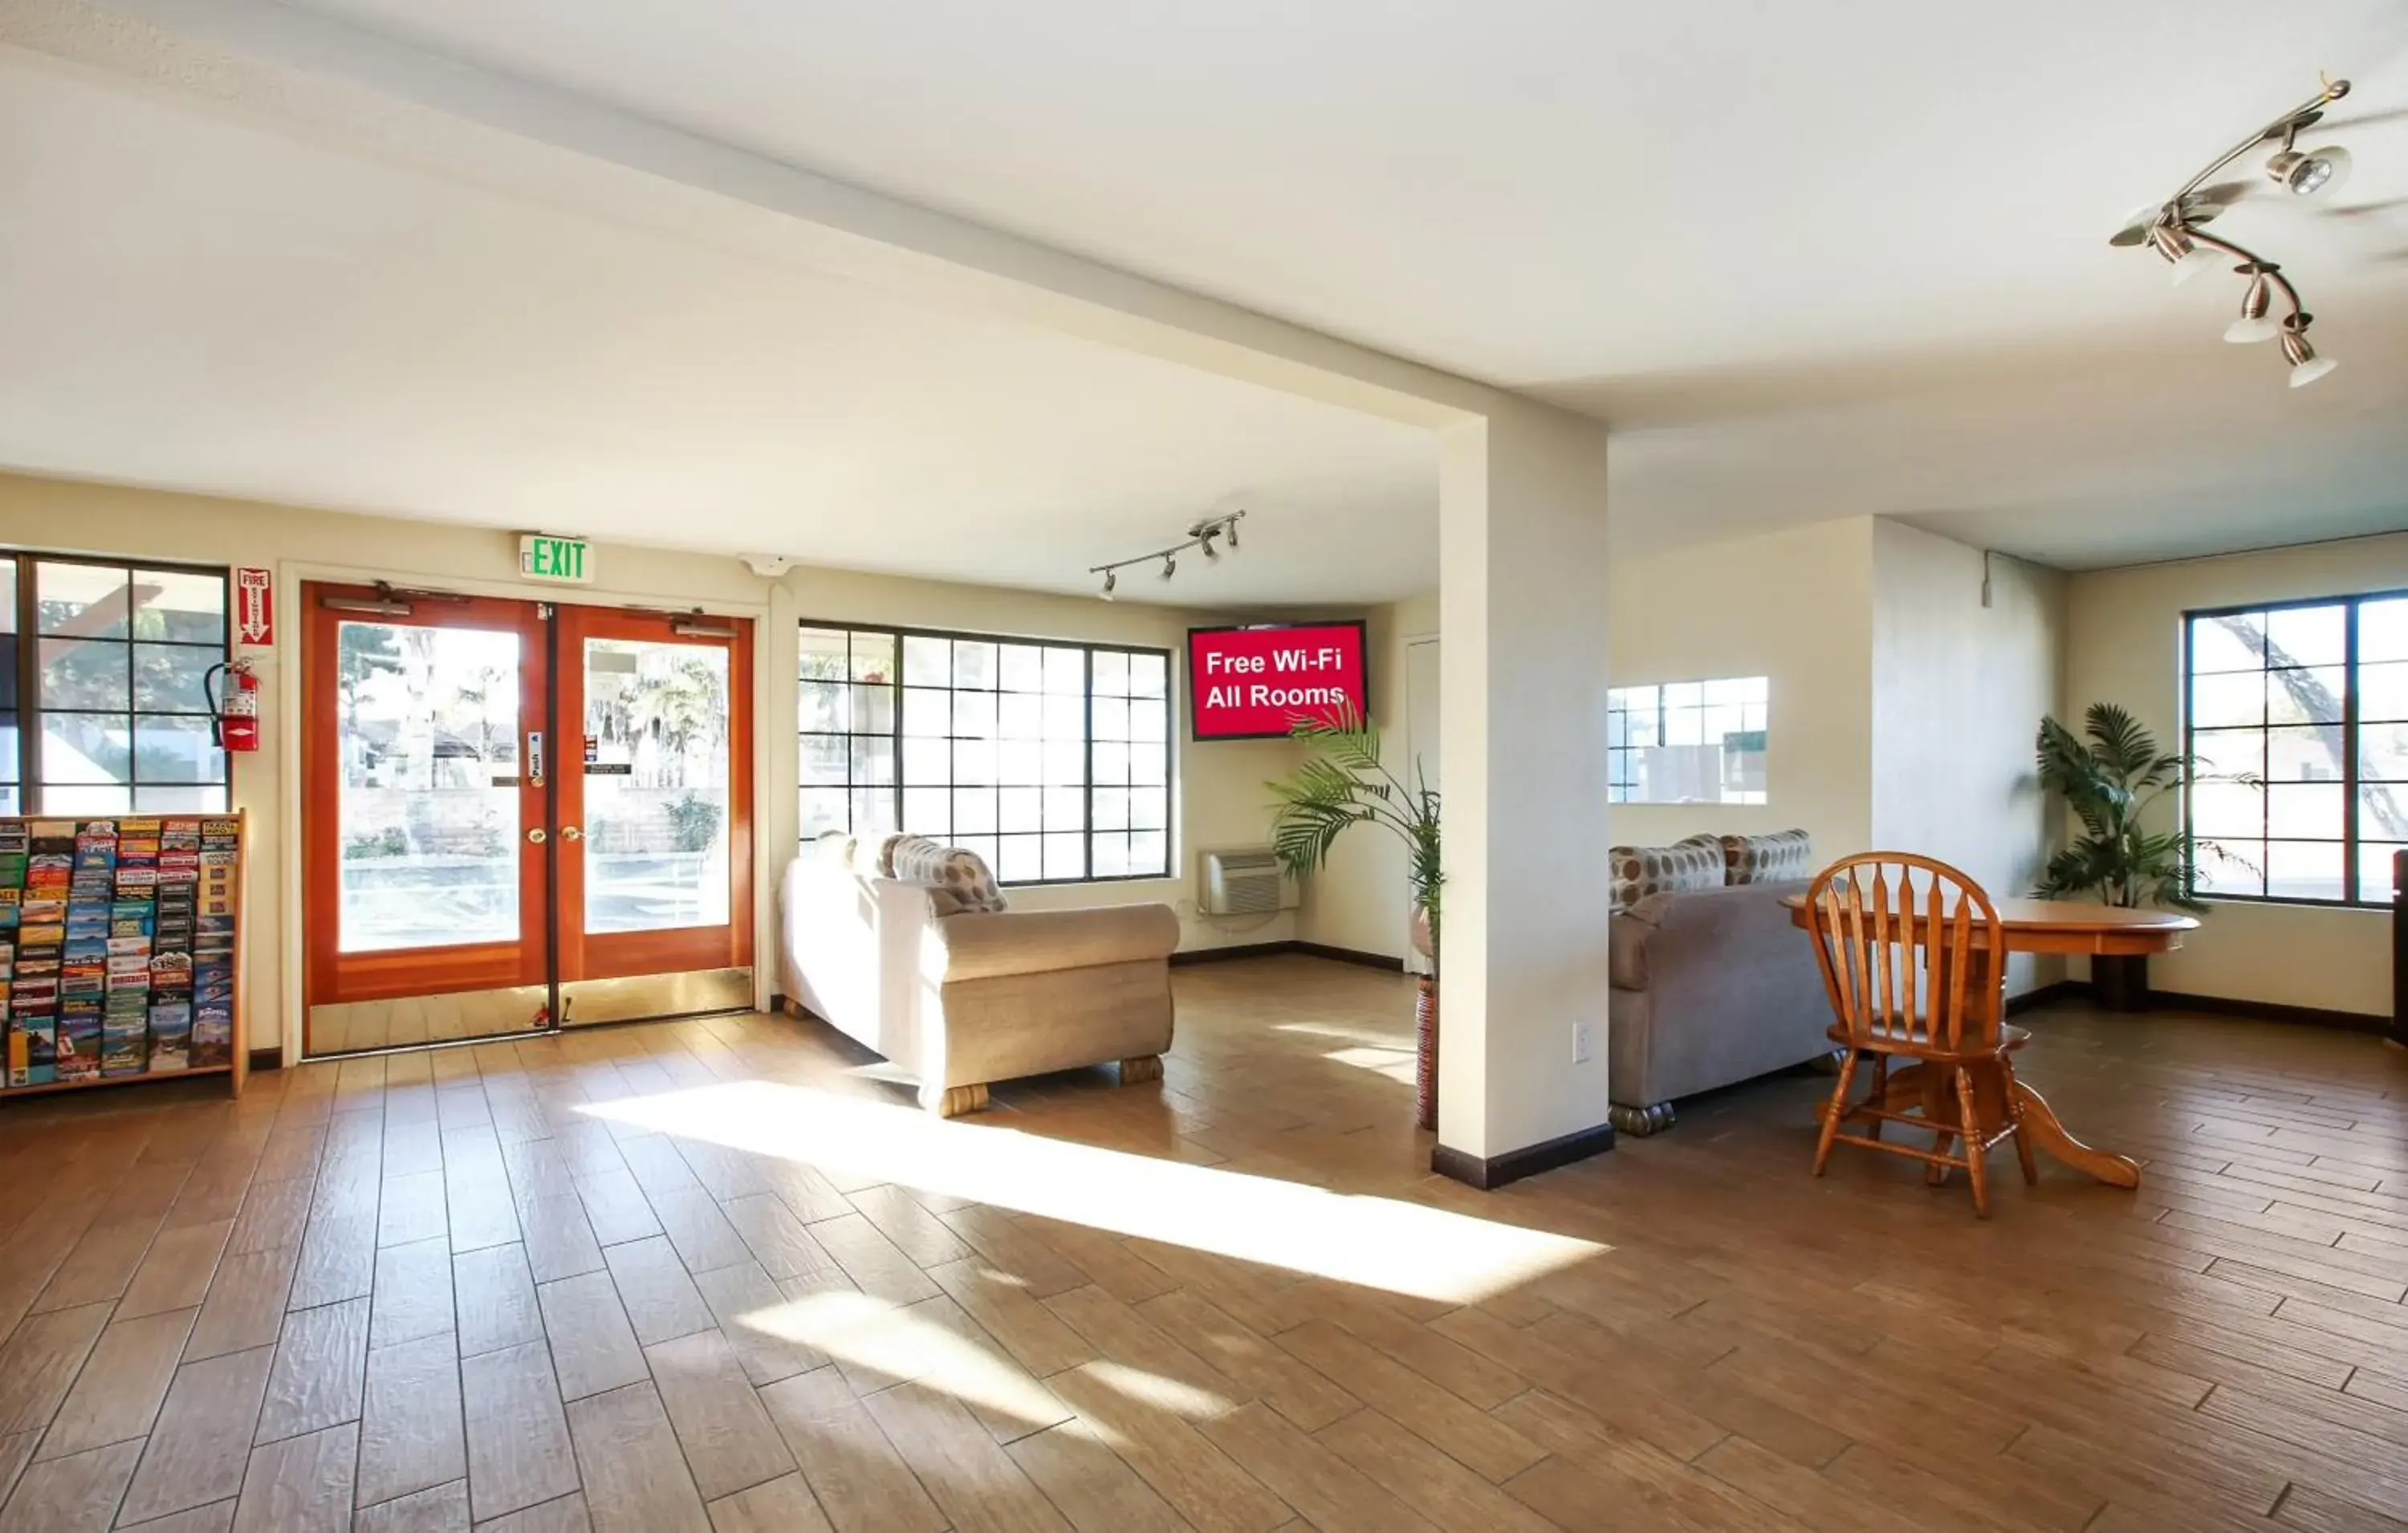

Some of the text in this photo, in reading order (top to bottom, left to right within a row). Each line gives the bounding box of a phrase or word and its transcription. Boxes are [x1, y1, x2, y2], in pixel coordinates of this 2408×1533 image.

[534, 539, 586, 579] EXIT
[243, 574, 266, 587] FIRE
[1206, 648, 1342, 674] Free Wi-Fi
[1205, 685, 1345, 709] All Rooms
